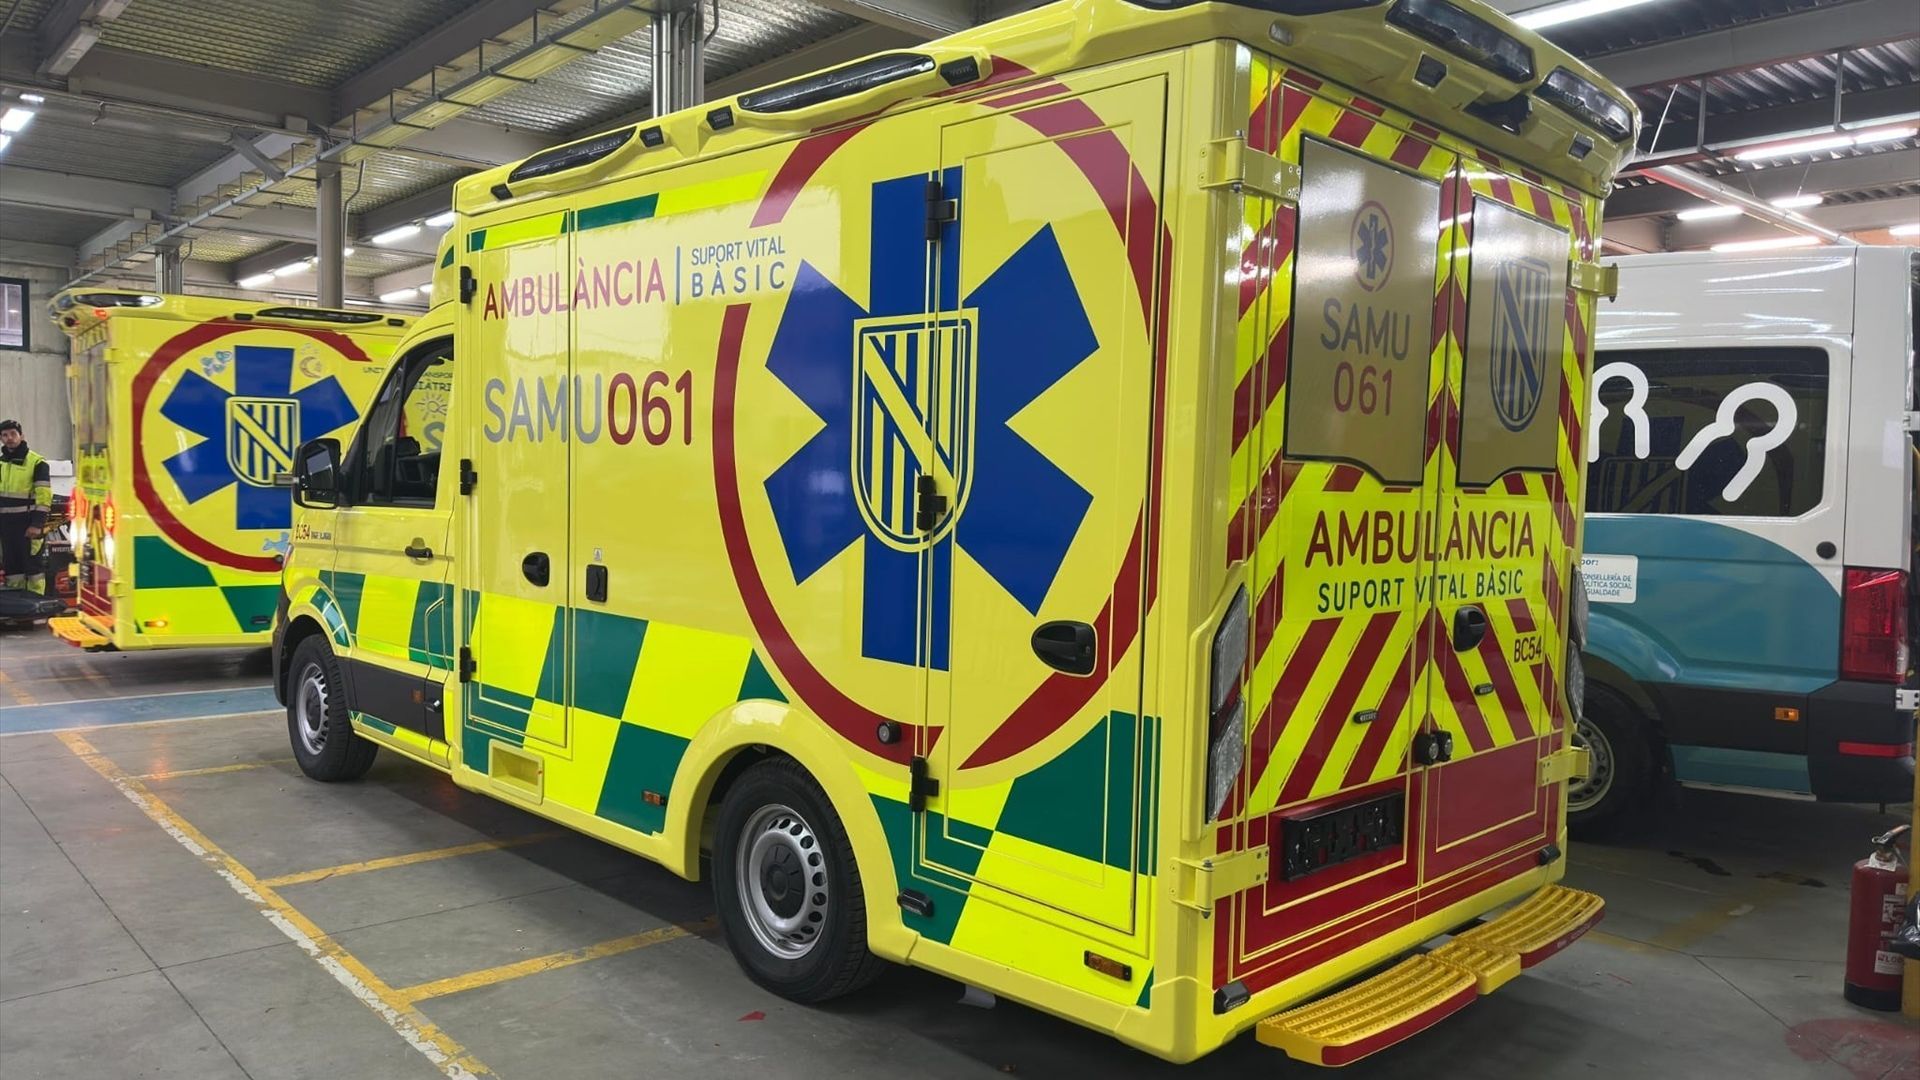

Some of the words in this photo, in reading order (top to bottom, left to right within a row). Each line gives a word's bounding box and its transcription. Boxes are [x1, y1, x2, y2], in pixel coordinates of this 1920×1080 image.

[691, 241, 743, 266] SUPORT
[746, 235, 786, 256] VITAL
[483, 257, 666, 321] AMBULÀNCIA
[691, 261, 786, 298] BÀSIC
[1320, 297, 1411, 361] SAMU
[1333, 361, 1393, 416] 061
[1305, 496, 1535, 569] AMBULÀNCIA
[1317, 577, 1406, 614] SUPORT
[1415, 574, 1468, 603] VITAL
[1475, 564, 1524, 597] BÀSIC
[1513, 635, 1543, 663] BC54
